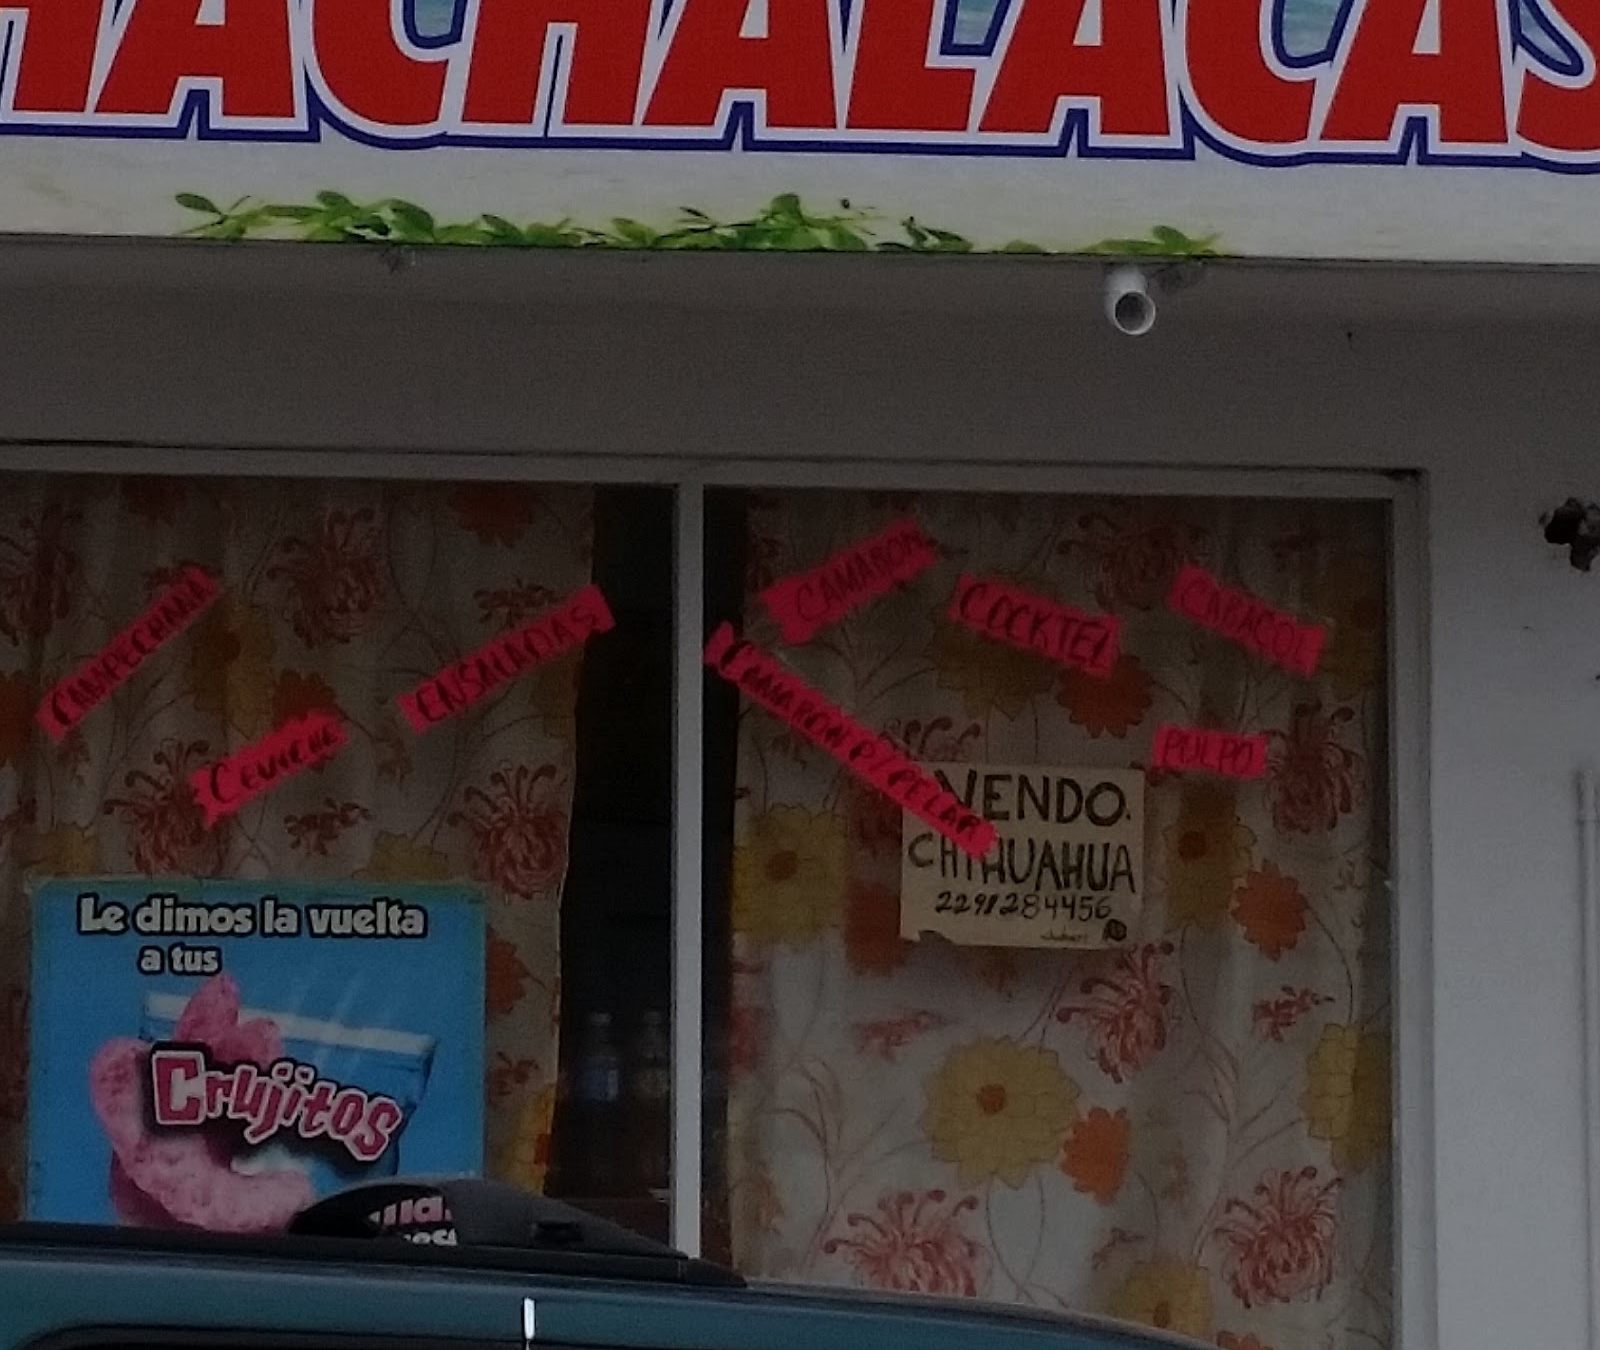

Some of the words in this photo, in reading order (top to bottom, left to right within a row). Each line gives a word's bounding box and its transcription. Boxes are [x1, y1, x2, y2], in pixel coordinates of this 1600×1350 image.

[958, 580, 1113, 671] COCKTEL
[415, 604, 600, 723] ENSALADAS
[1160, 726, 1256, 774] PULPO
[79, 896, 125, 934] Le
[134, 897, 254, 936] dimos
[262, 898, 299, 936] la
[309, 899, 427, 937] vuelta
[138, 947, 162, 973] a
[170, 944, 221, 974] tus
[151, 1050, 403, 1162] Crujitos
